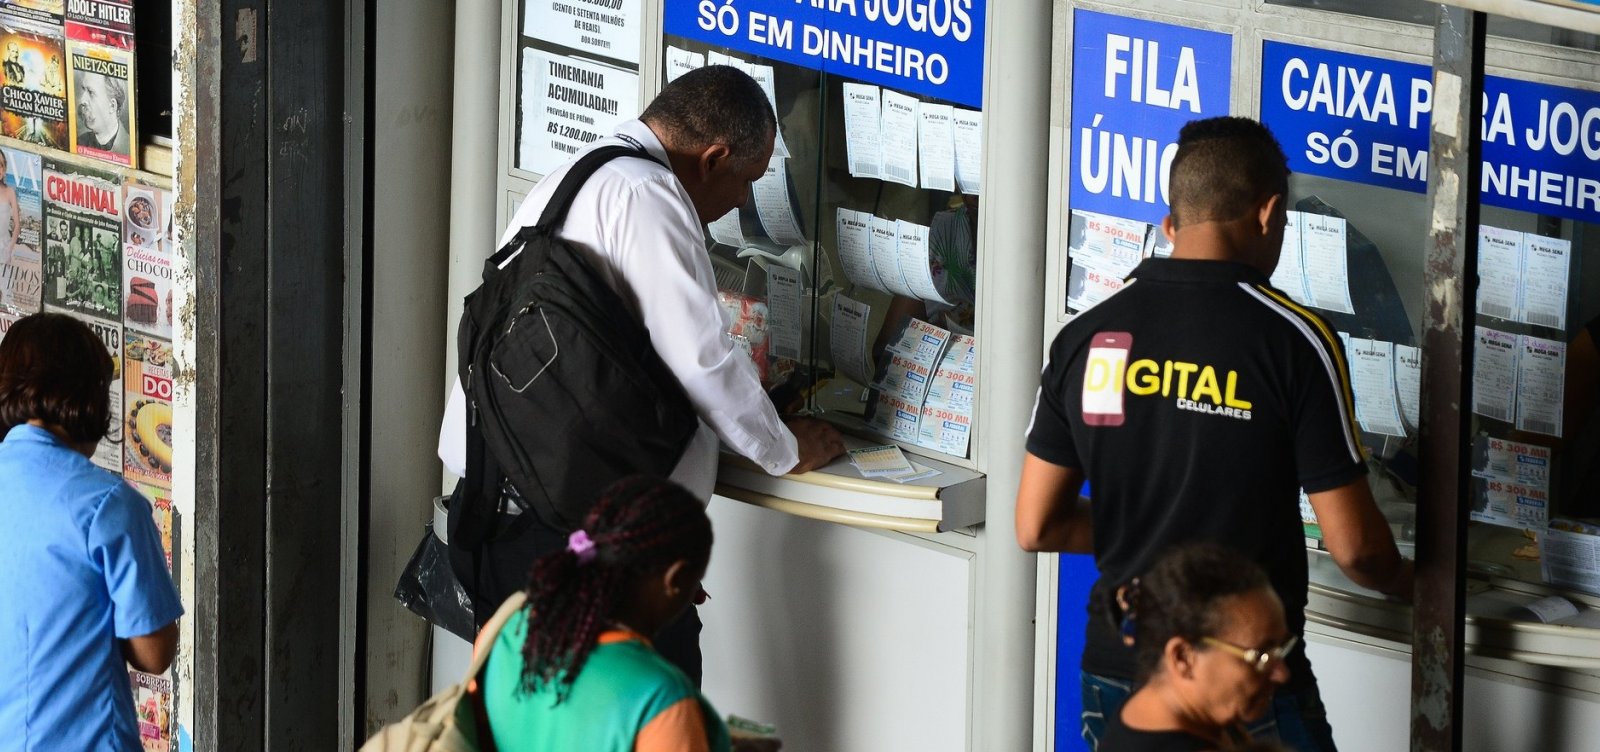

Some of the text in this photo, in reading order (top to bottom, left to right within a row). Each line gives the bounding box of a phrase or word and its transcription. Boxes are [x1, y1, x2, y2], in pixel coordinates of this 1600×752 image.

[68, 0, 97, 17] ADOLF
[98, 3, 130, 24] HITLER
[577, 8, 600, 22] SETENTA
[600, 13, 625, 27] MILHÕES
[574, 19, 581, 29] DE
[698, 0, 949, 85] SÓ EM DINHEIRO
[73, 55, 128, 79] NIETZSCHE
[548, 60, 604, 90] TIMEMANIA
[1104, 33, 1201, 113] FILA
[3, 86, 64, 109] CHICO XAVIER
[547, 83, 618, 116] ACUMULADA!!!
[1282, 57, 1398, 126] CAIXA
[9, 98, 33, 111] ALLAN
[34, 104, 64, 118] KARDEC
[569, 112, 576, 120] DE
[547, 121, 558, 134] R$
[1305, 129, 1359, 168] SÓ
[1371, 142, 1428, 182] EM
[47, 175, 118, 216] CRIMINAL
[1104, 226, 1123, 238] 300
[1126, 233, 1142, 243] MIL
[920, 324, 934, 335] 300
[934, 329, 946, 340] MIL
[902, 360, 916, 371] 300
[916, 366, 928, 376] MIL
[946, 371, 964, 381] 300
[1085, 358, 1252, 410] DIGITAL
[889, 398, 905, 409] 300
[906, 404, 919, 415] MIL
[923, 407, 970, 425] R$ 300 MIL
[1176, 397, 1252, 420] CELULARES
[1507, 443, 1528, 454] 300
[1505, 485, 1527, 495] 300
